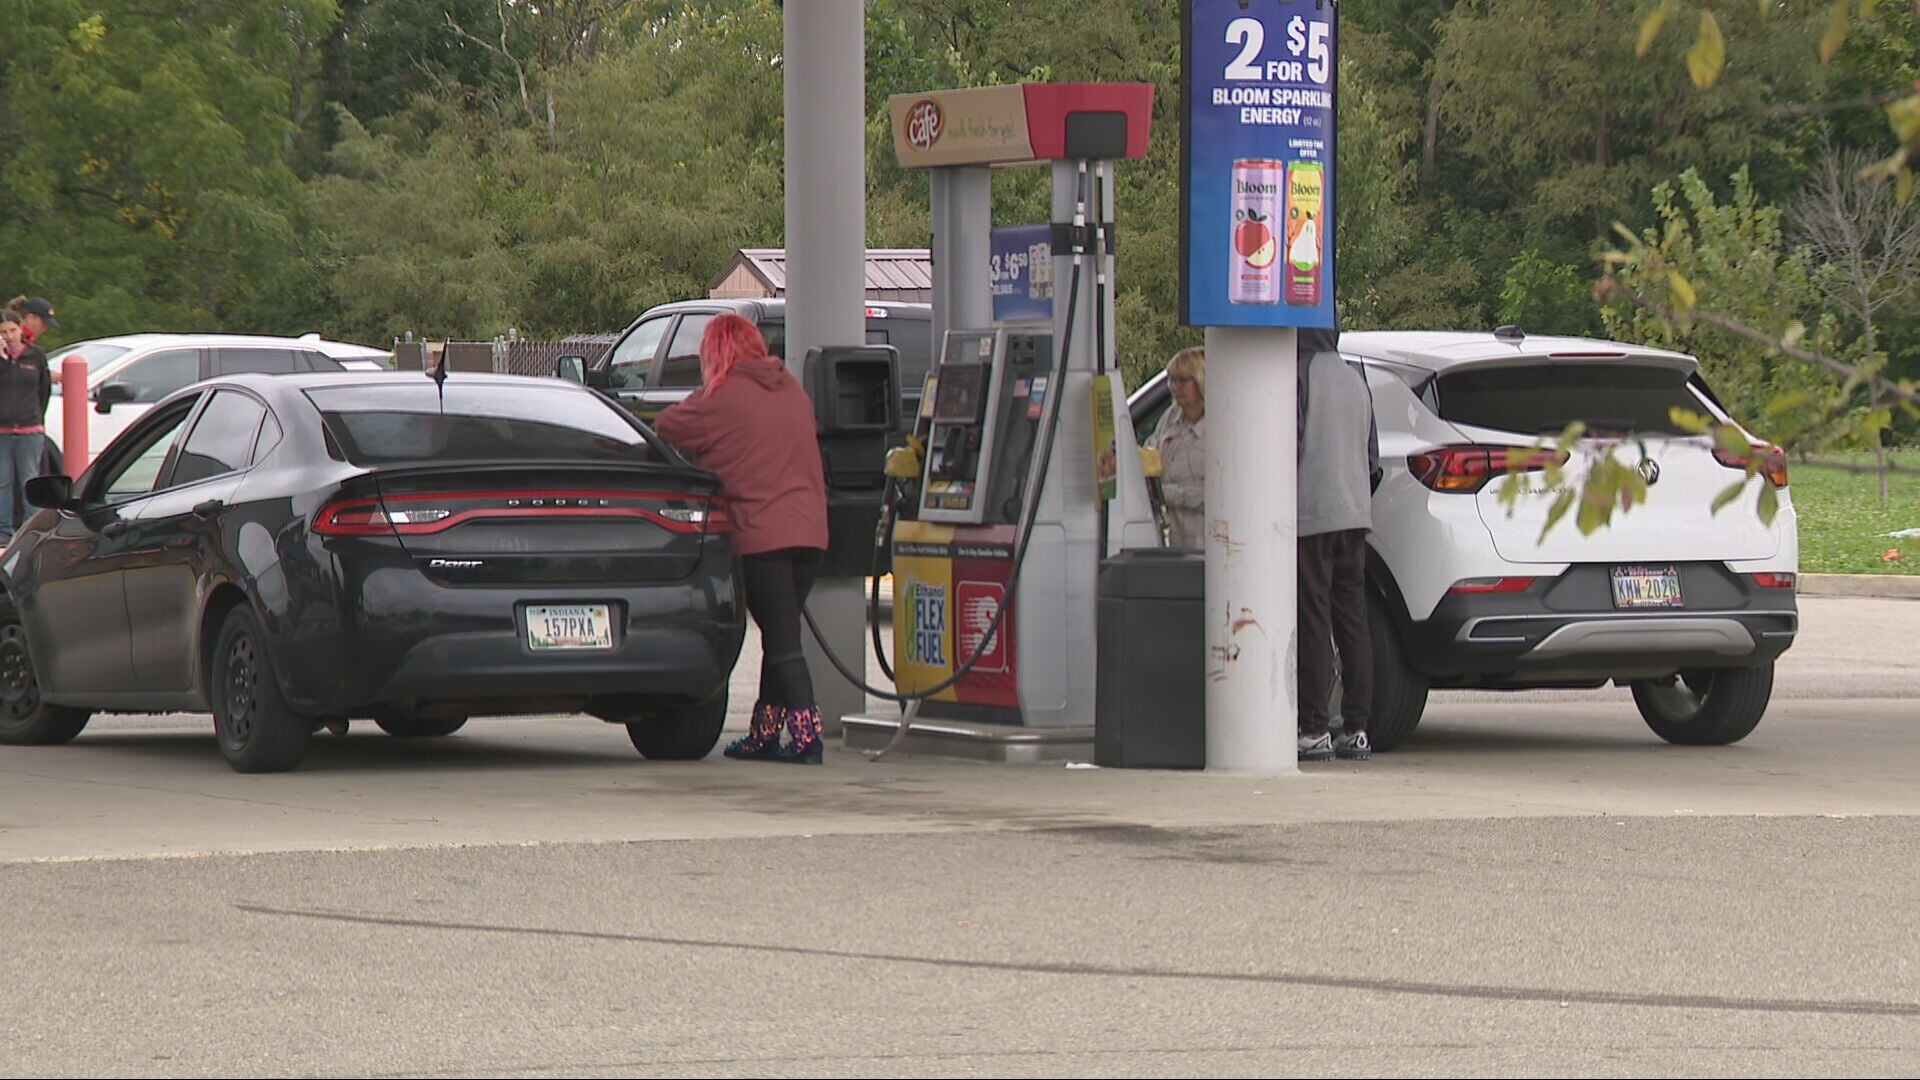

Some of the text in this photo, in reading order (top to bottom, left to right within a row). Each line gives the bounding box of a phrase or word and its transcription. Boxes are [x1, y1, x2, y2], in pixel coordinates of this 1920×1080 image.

[1224, 15, 1330, 84] 2 FOR $5
[1212, 88, 1270, 105] BLOOM
[1240, 107, 1302, 125] ENERGY
[1237, 181, 1277, 194] Bloom
[1291, 181, 1321, 195] Bloom
[916, 583, 945, 596] Ethanol
[1645, 579, 1677, 598] 2026
[549, 608, 586, 617] INDIANA
[916, 599, 945, 631] FLEX
[544, 617, 595, 637] 157PXA
[916, 632, 945, 665] FUEL
